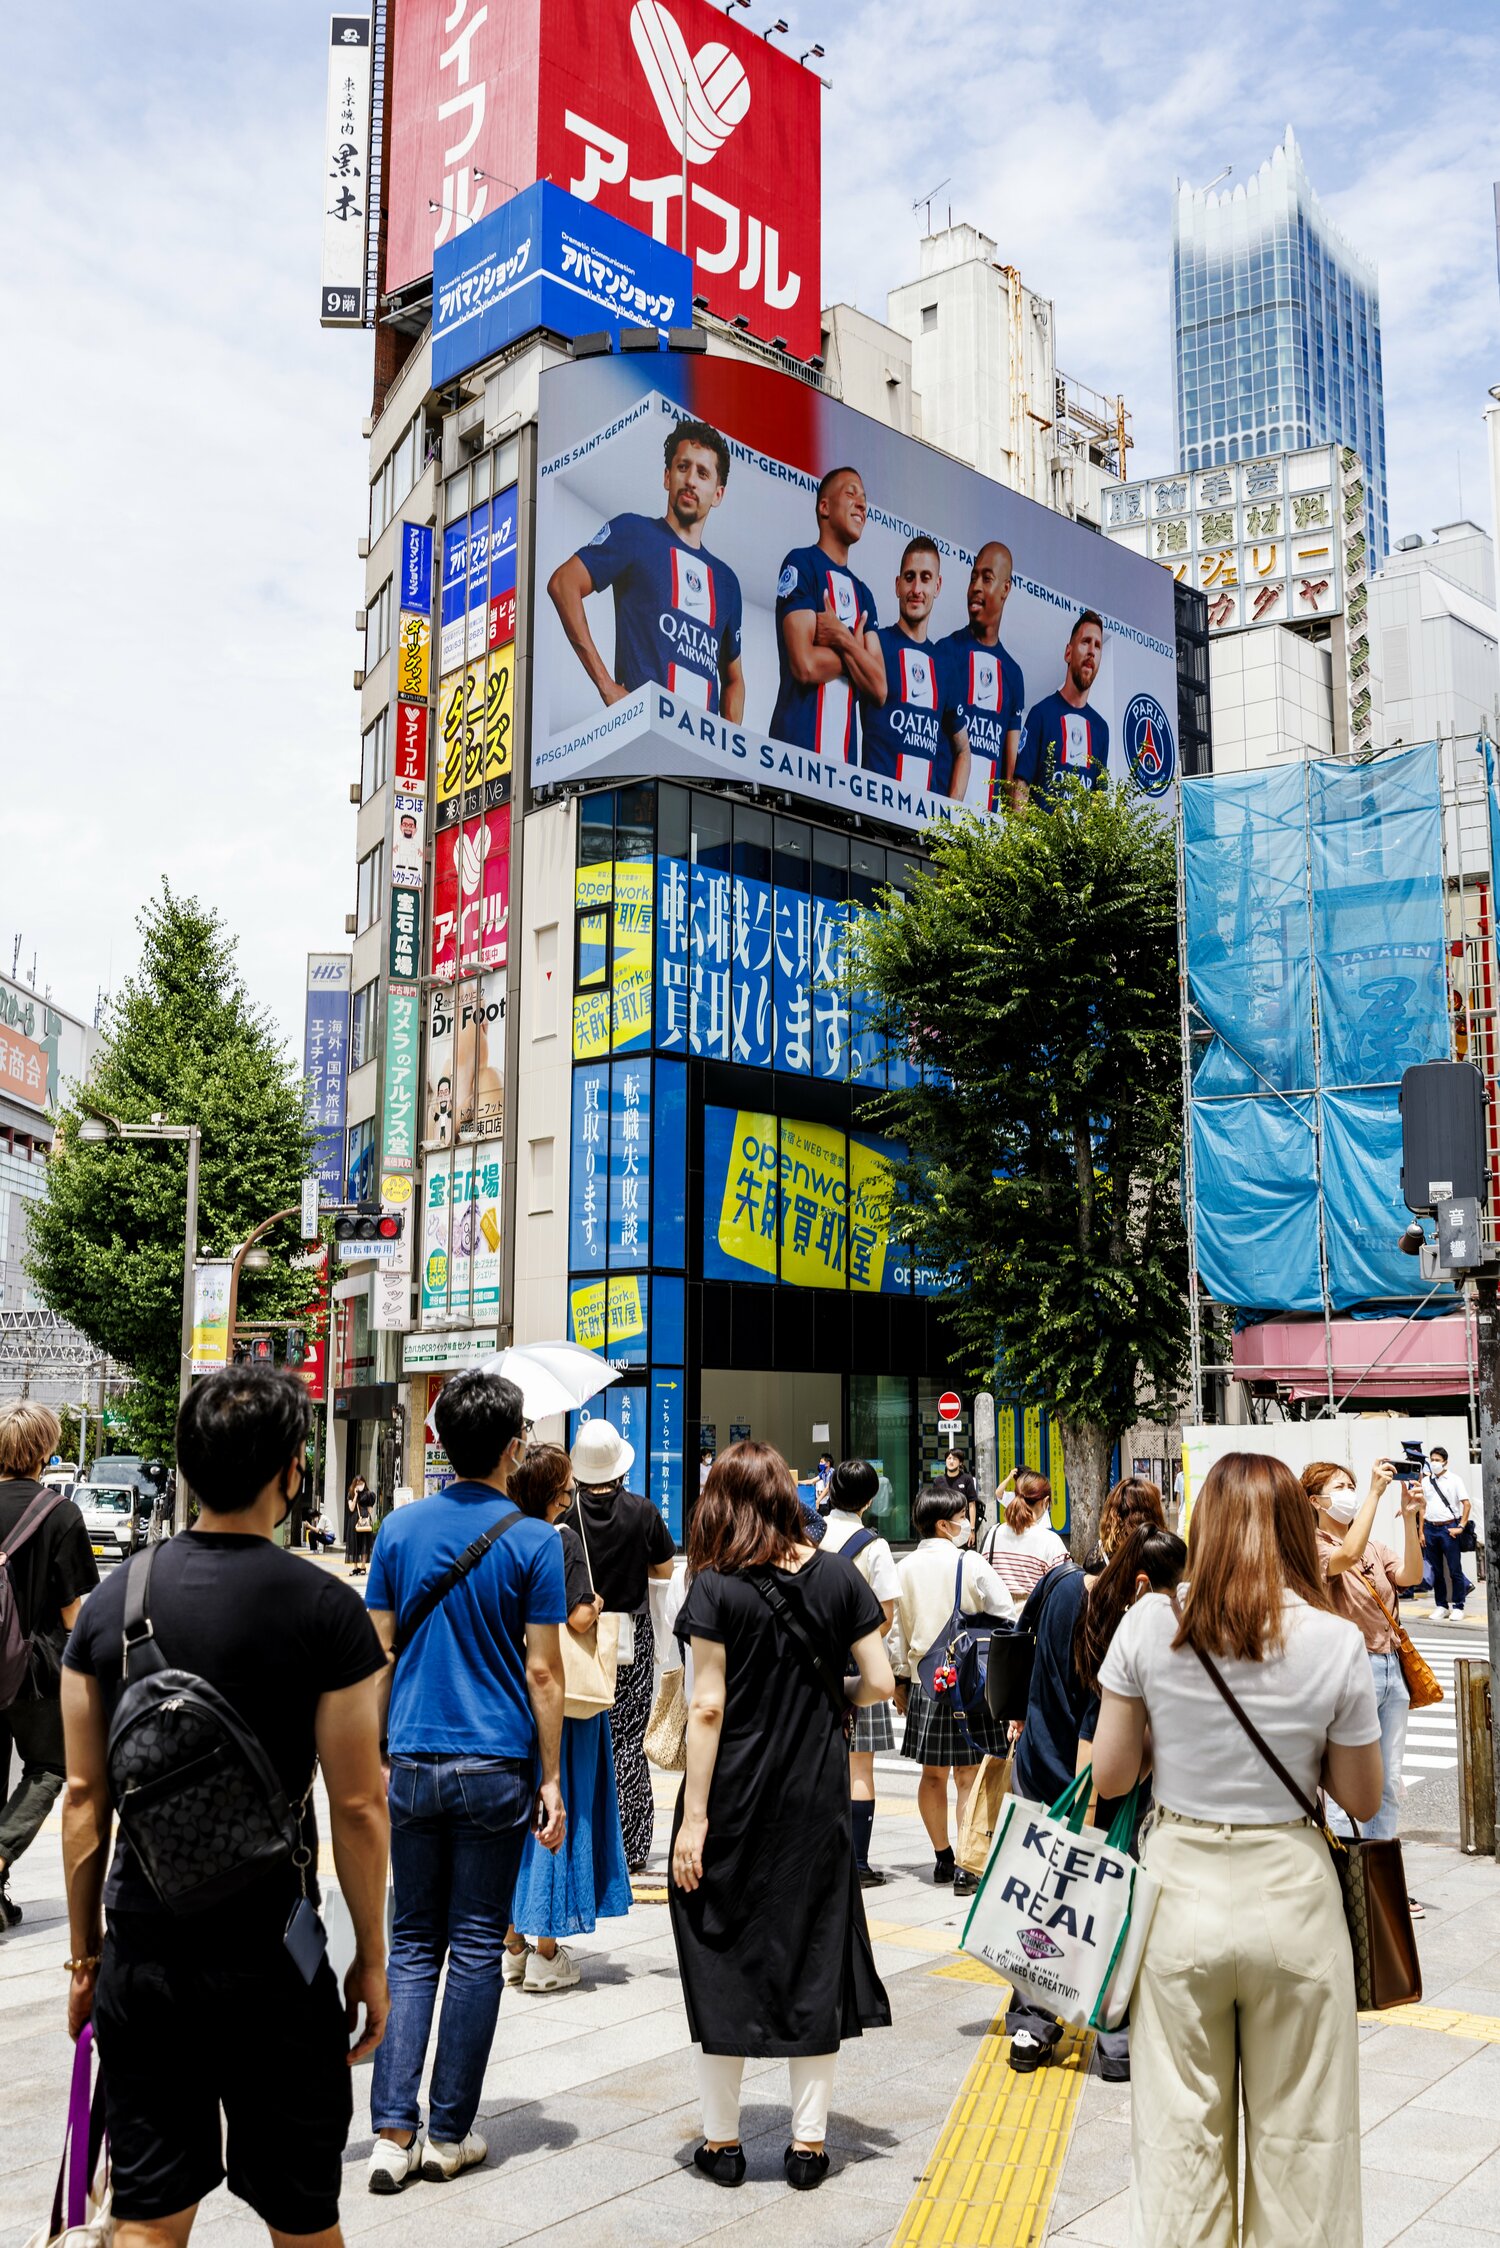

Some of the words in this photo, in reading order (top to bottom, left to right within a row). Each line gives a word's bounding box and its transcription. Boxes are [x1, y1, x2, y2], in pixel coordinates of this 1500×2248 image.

[327, 143, 363, 222] 黒木
[565, 109, 801, 310] アイフル
[327, 292, 356, 312] 9階
[438, 238, 531, 323] アパマンショップ
[561, 243, 675, 322] アパマンショップ
[541, 454, 570, 477] PARIS
[572, 400, 650, 461] SAINT-GERMAIN
[1109, 463, 1279, 523] 服飾手芸
[1156, 494, 1330, 552] 洋装材料
[1161, 545, 1329, 587] ンジェリー
[405, 619, 424, 693] ダーツグッズ
[659, 613, 718, 661] QATAR
[676, 644, 718, 676] AIRWAYS
[535, 701, 644, 766] #PSGJAPANTOUR2022
[890, 710, 939, 742] QATAR
[1132, 702, 1165, 730] PARIS
[404, 722, 418, 776] アイフル
[660, 695, 747, 758] PARIS
[760, 745, 951, 822] SAINT-GERMAIN
[904, 731, 937, 755] AIRWAYS
[969, 734, 1000, 757] AIRWAYS
[402, 780, 417, 791] 4F
[395, 893, 414, 976] 宝石広場
[312, 965, 346, 979] HIS
[389, 984, 416, 997] 中古専門
[432, 1014, 454, 1038] Dr
[462, 997, 506, 1030] Foot
[325, 1019, 343, 1125] 海外・国内旅行
[388, 998, 412, 1155] カメラのアルプス堂
[582, 1078, 600, 1256] 買取ります。
[621, 1074, 640, 1256] 転職失敗談、
[781, 1128, 854, 1175] 新宿とWEBで営業!
[428, 1163, 500, 1208] 宝石広場
[343, 1245, 393, 1255] 自転車専用
[732, 1167, 878, 1286] 失敗買取屋
[1022, 1822, 1124, 1884] KEEP
[1040, 1866, 1078, 1900] IT
[1001, 1876, 1096, 1948] REAL
[1030, 1930, 1046, 1941] MAKE
[981, 1945, 994, 1959] ALL
[997, 1950, 1010, 1968] YOU
[1009, 1962, 1028, 1978] NEED
[1029, 1971, 1037, 1983] IS
[1005, 1949, 1025, 1963] MICKEY
[1034, 1965, 1059, 1979] MINNIE
[1025, 1936, 1050, 1952] THINGS
